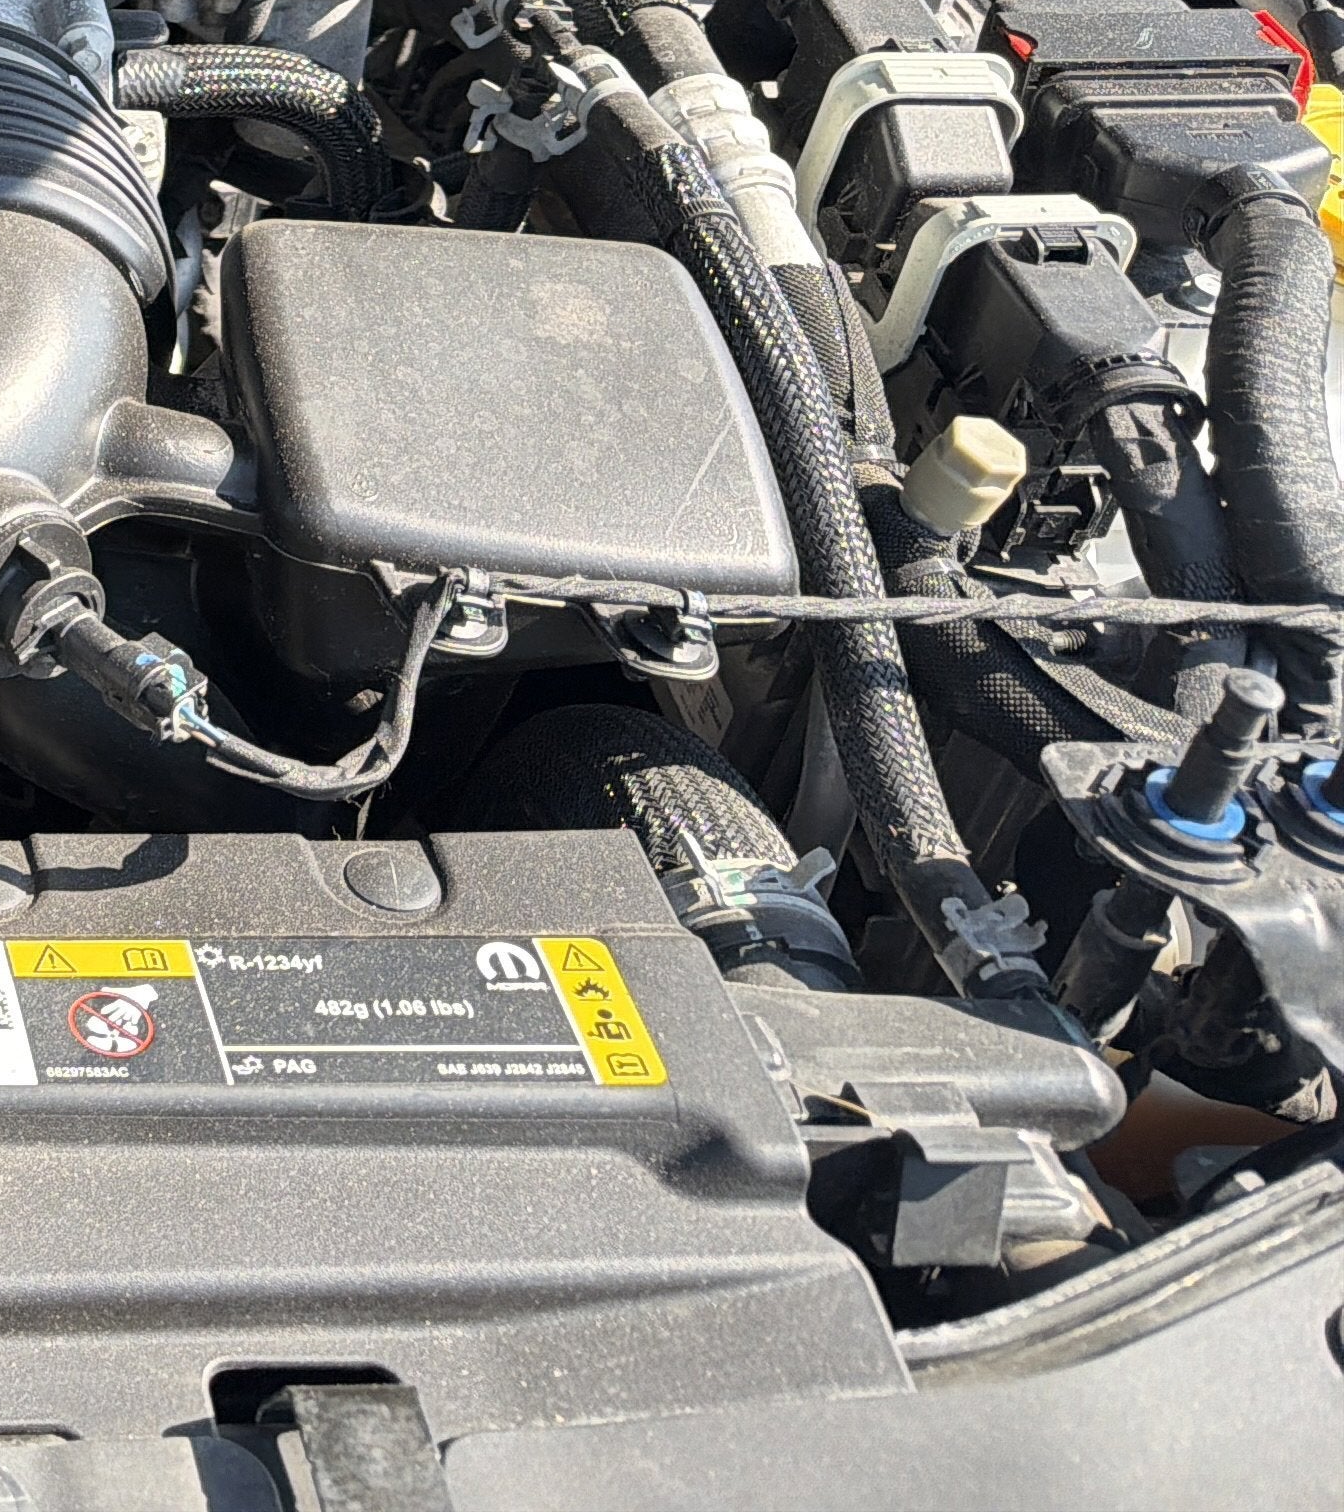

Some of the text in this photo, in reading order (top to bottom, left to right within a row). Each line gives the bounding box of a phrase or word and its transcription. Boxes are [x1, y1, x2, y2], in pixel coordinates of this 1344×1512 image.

[228, 954, 323, 974] R-1234yf
[314, 998, 475, 1020] 482g (1.06 lbs)
[272, 1058, 317, 1074] PAG
[437, 1063, 468, 1075] SAE
